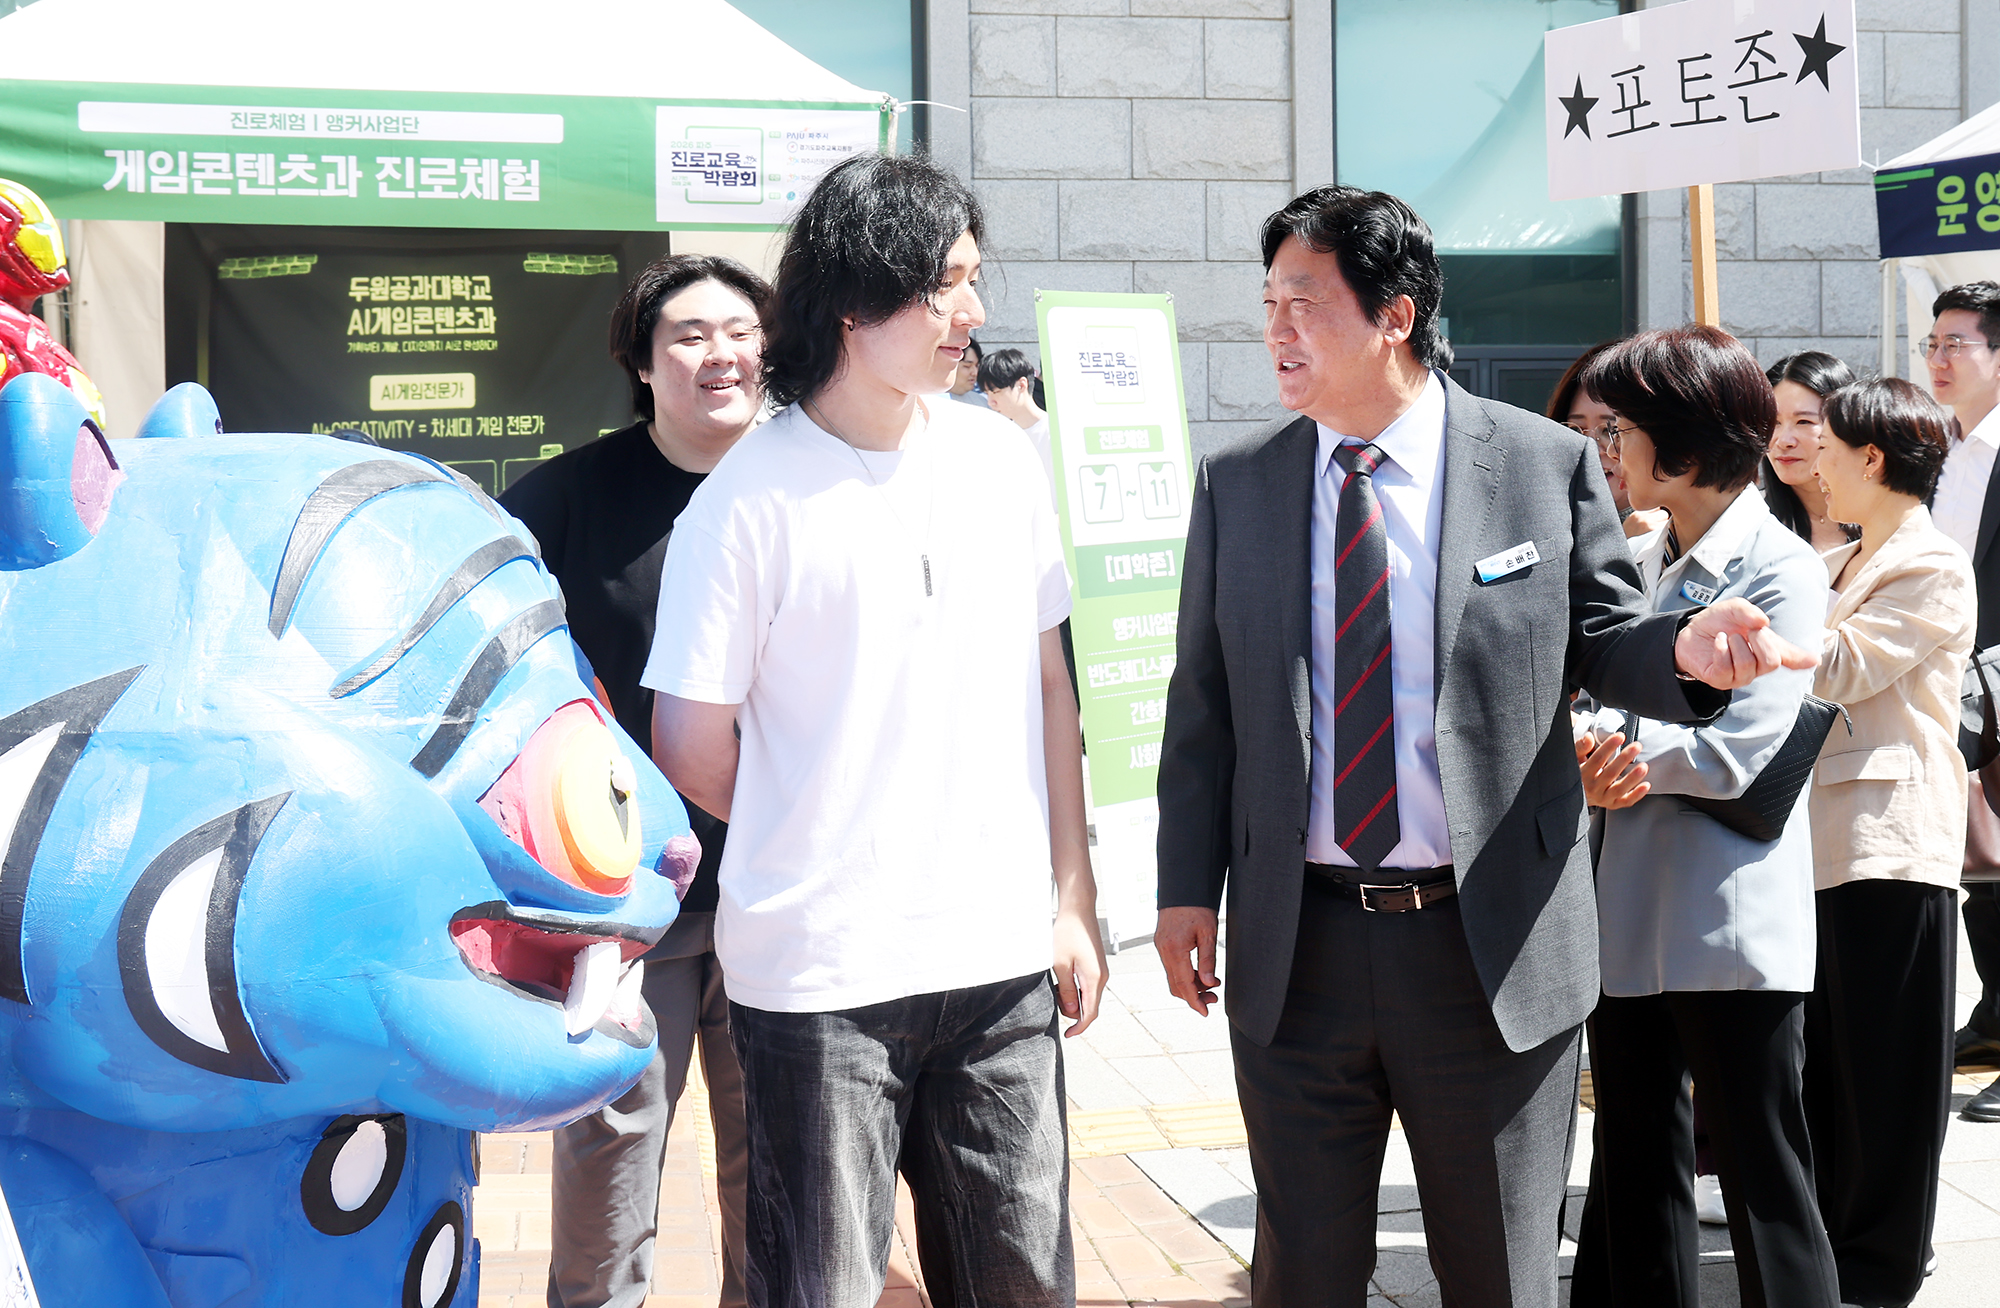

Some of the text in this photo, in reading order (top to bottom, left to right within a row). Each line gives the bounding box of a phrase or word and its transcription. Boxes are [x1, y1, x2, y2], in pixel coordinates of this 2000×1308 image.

[1606, 29, 1788, 139] 포토존
[230, 111, 306, 132] 진로체험
[326, 113, 420, 134] 앵커사업단
[671, 141, 694, 149] 2026
[671, 151, 741, 168] 진로교육
[102, 148, 541, 201] 게임콘텐츠과 진로체험
[703, 170, 756, 187] 박람회
[348, 275, 493, 302] 두원공과대학교
[347, 306, 497, 336] AI게임콘텐츠과
[1078, 351, 1127, 368] 진로교육
[381, 382, 464, 400] AI게임전문가
[1103, 370, 1140, 387] 박람회
[431, 417, 473, 438] 차세대
[476, 416, 503, 437] 게임
[506, 415, 546, 435] 전문가
[1094, 482, 1107, 510] 7
[1150, 478, 1170, 506] 11
[1104, 549, 1177, 583] [대학존]
[1087, 654, 1177, 688] 반도체디스플
[1129, 742, 1162, 769] 사회
